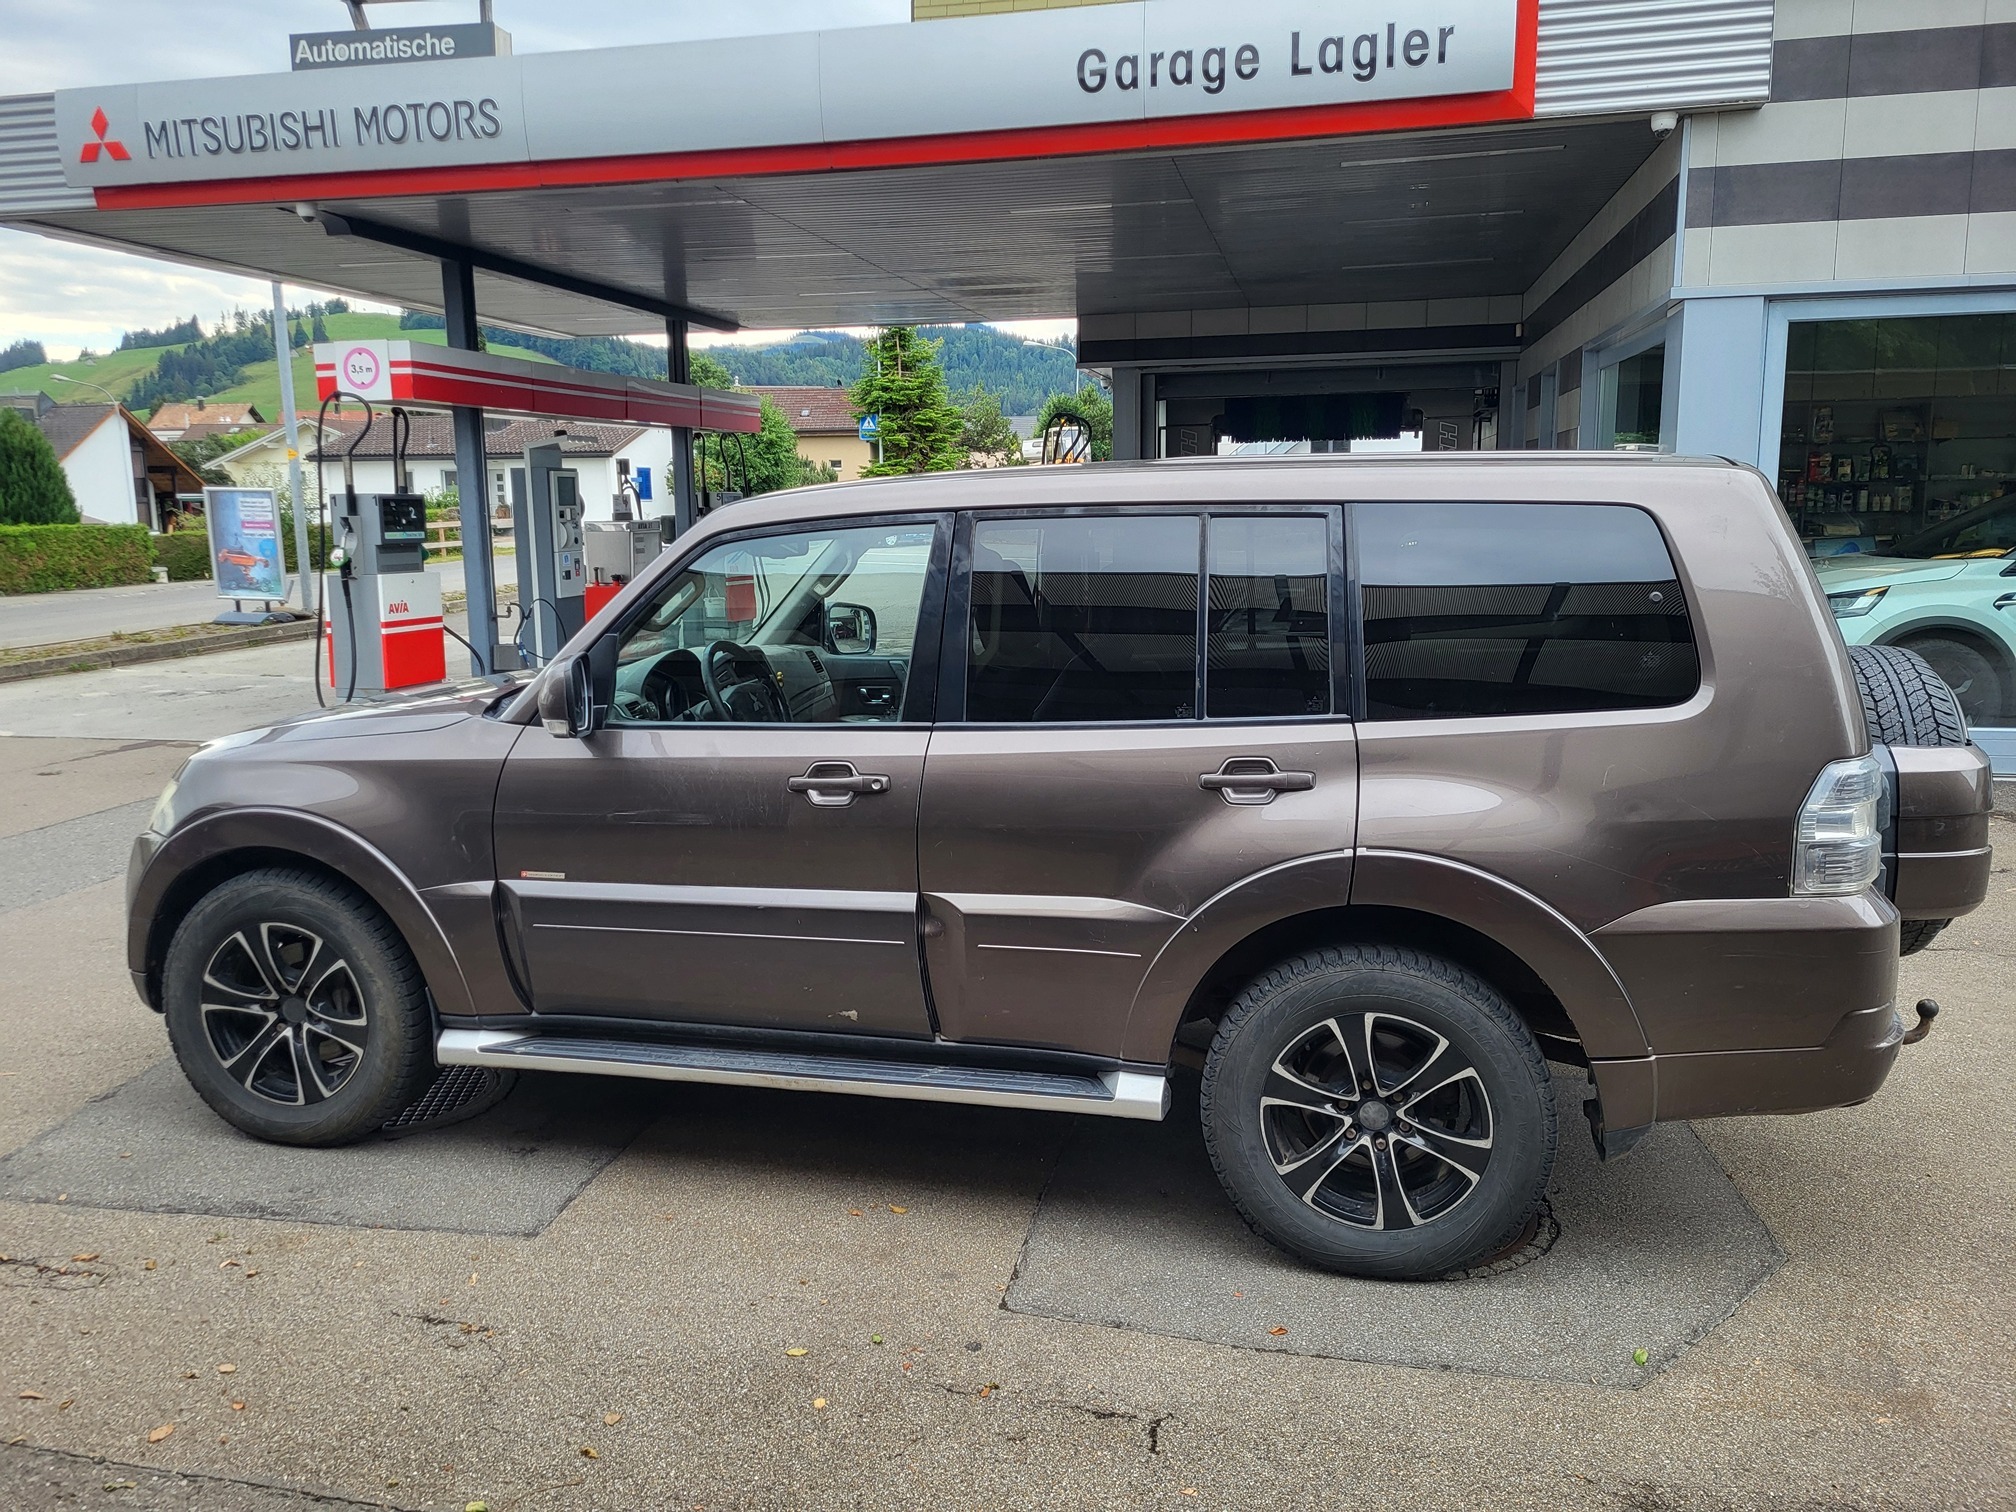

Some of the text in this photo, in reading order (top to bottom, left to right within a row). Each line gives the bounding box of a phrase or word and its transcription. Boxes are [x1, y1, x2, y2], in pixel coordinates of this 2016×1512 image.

[295, 32, 455, 64] Automatische
[1076, 21, 1455, 95] Garage Lagler
[144, 98, 502, 159] MITSUBISHI MOTORS
[351, 364, 364, 375] 3,5
[331, 495, 337, 507] 1
[372, 495, 378, 506] 1
[408, 506, 417, 519] 2
